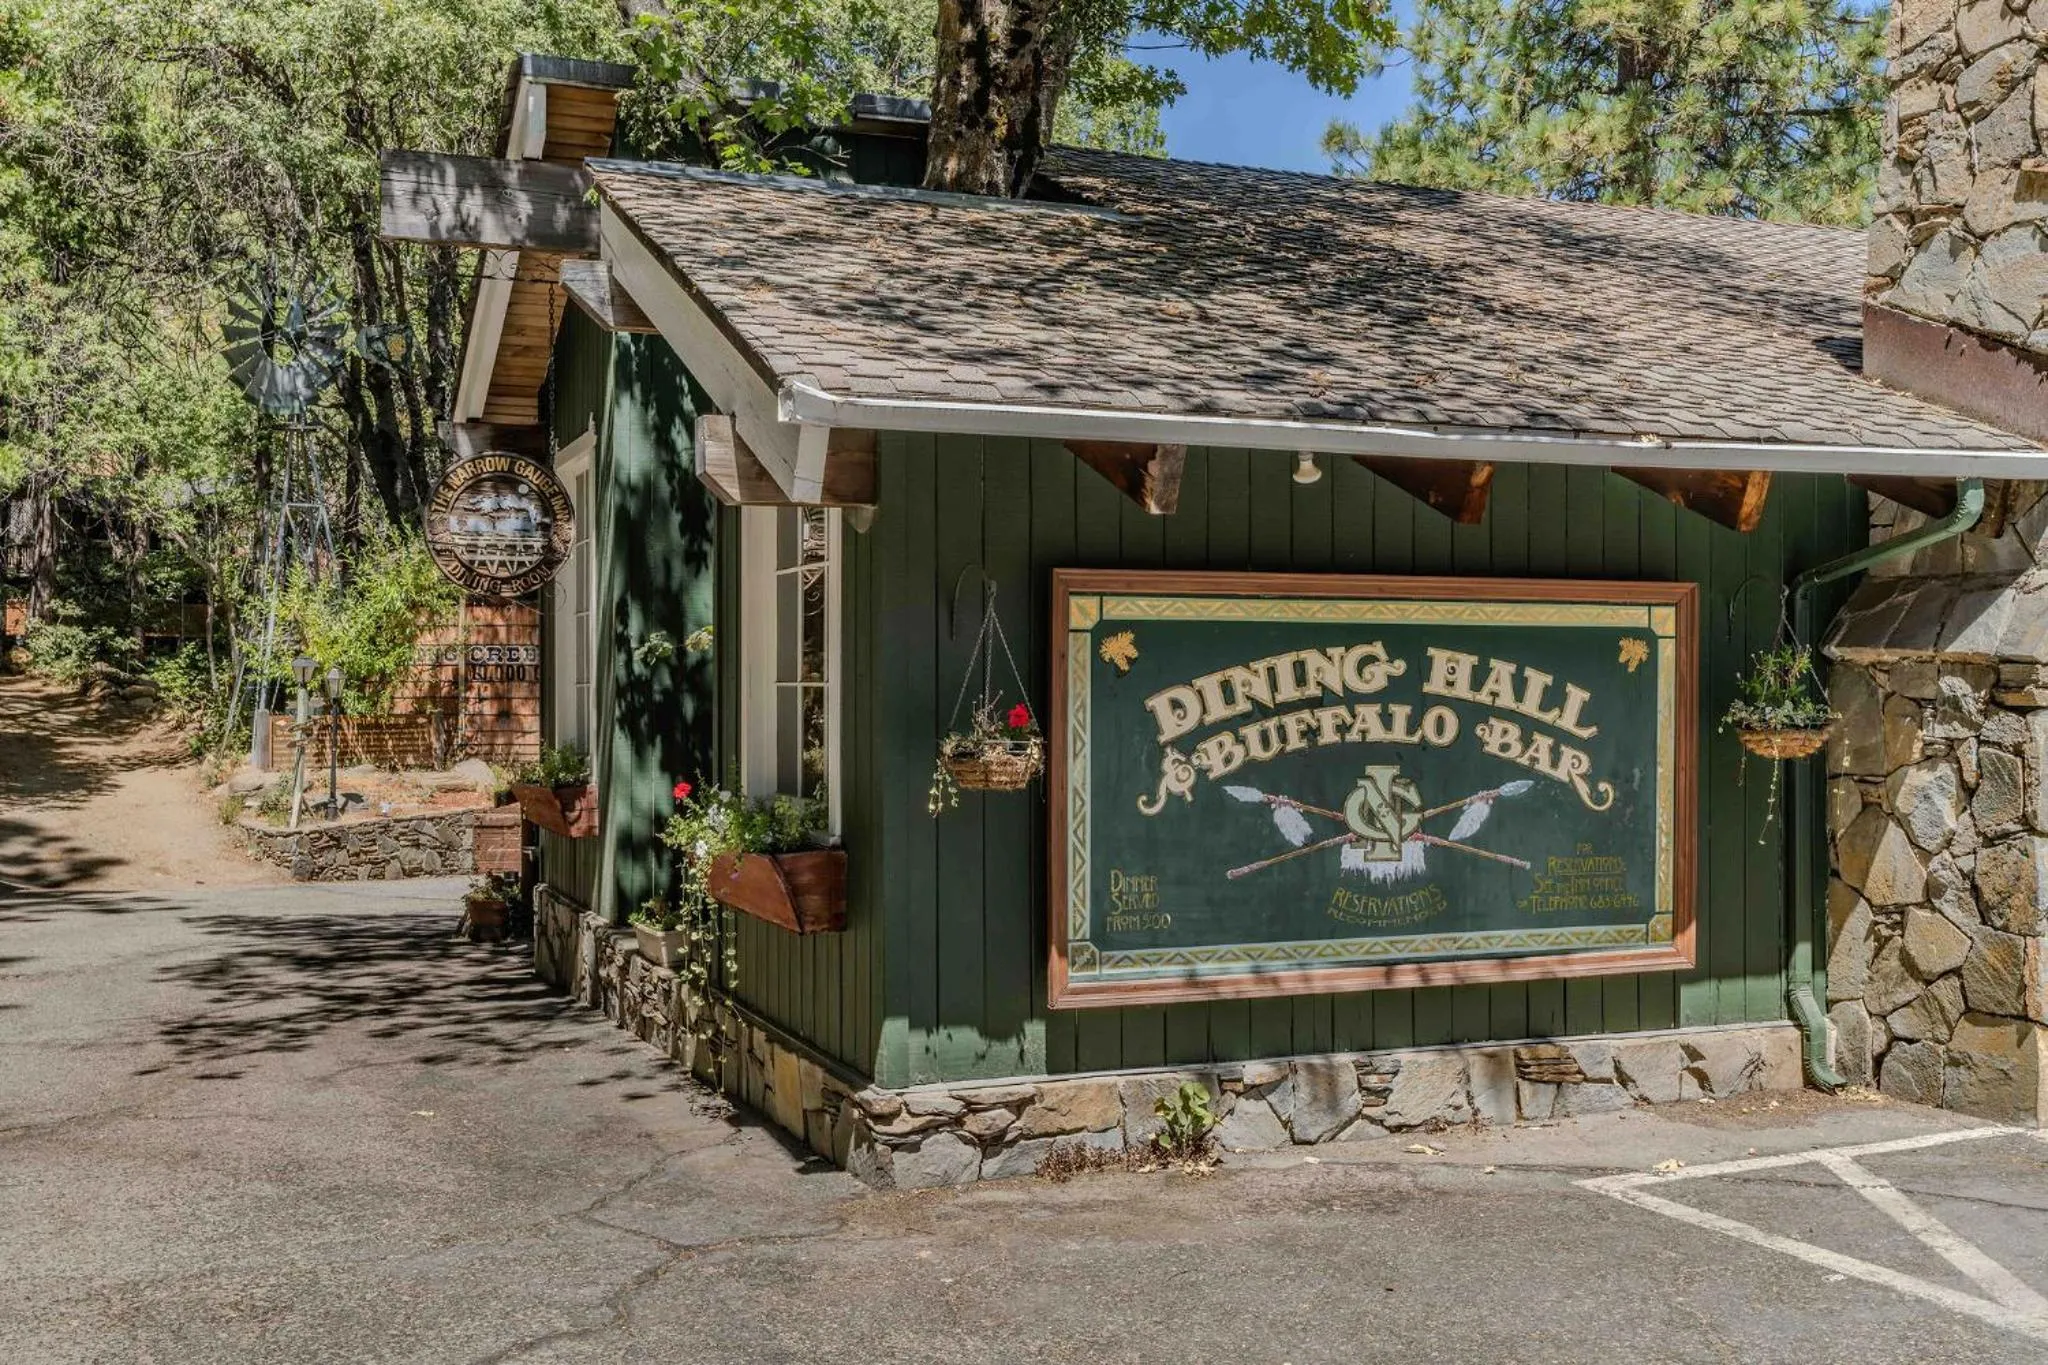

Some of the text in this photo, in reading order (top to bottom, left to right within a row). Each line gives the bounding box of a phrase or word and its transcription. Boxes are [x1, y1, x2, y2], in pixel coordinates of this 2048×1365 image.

[433, 456, 570, 522] THE NARROW GAUGE INN
[448, 563, 551, 593] DINING ROOM
[1143, 640, 1599, 744] DINING HALL
[1137, 703, 1615, 816] & BUFFALO BAR
[1332, 884, 1442, 917] RESERVATIONS
